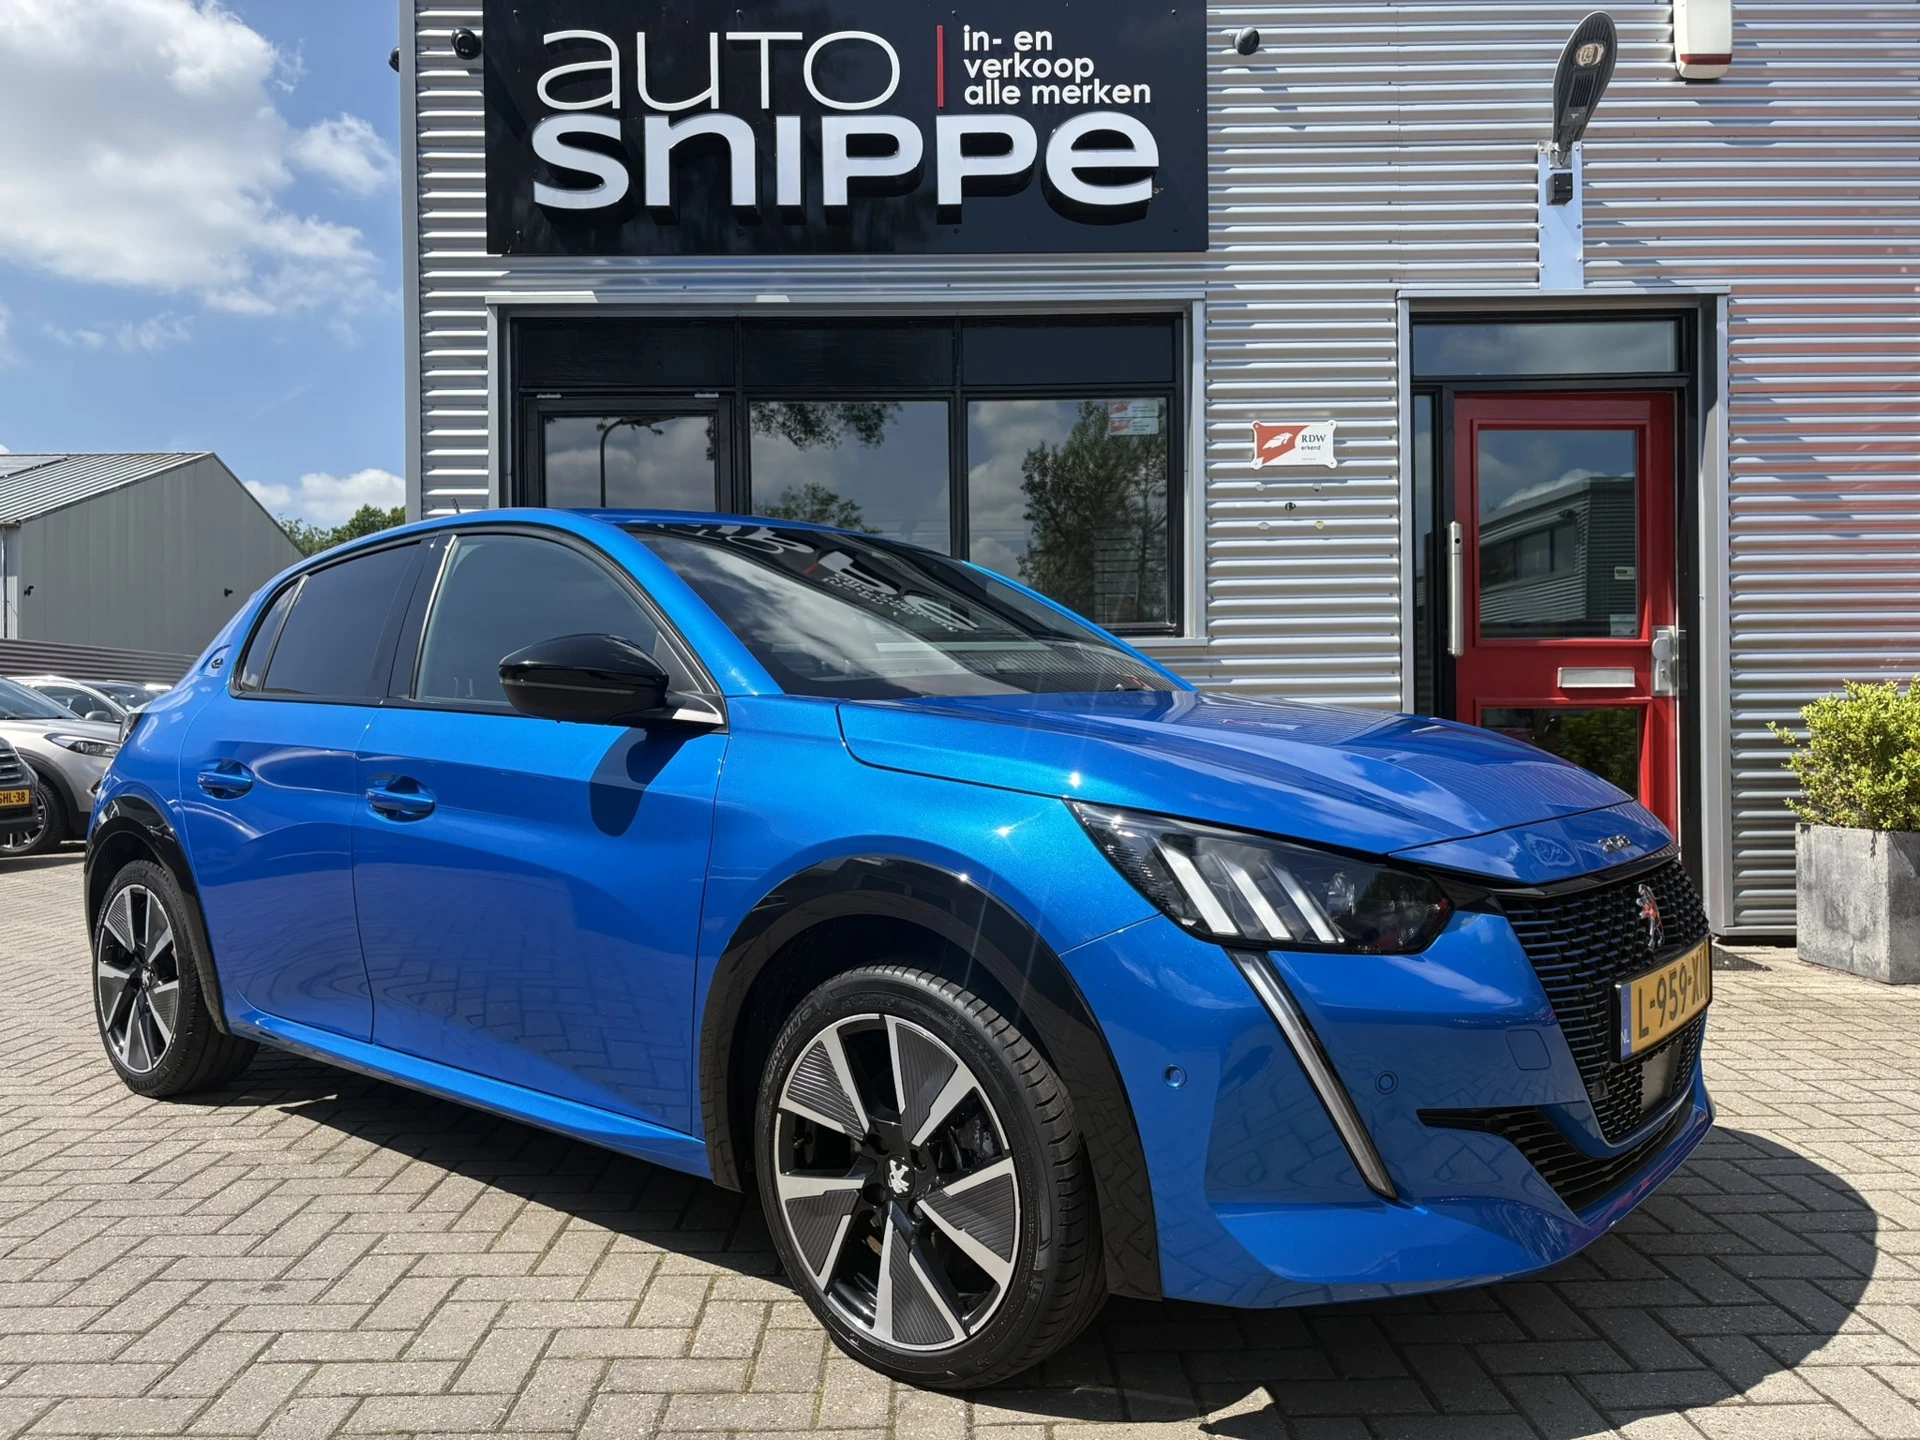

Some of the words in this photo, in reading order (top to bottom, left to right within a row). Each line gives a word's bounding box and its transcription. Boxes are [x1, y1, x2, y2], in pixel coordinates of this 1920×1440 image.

[964, 24, 1002, 51] in-
[1014, 30, 1053, 51] en
[963, 52, 1095, 84] verkoop
[964, 79, 1021, 105] alle
[1031, 78, 1151, 105] merken
[1301, 434, 1326, 442] RDW
